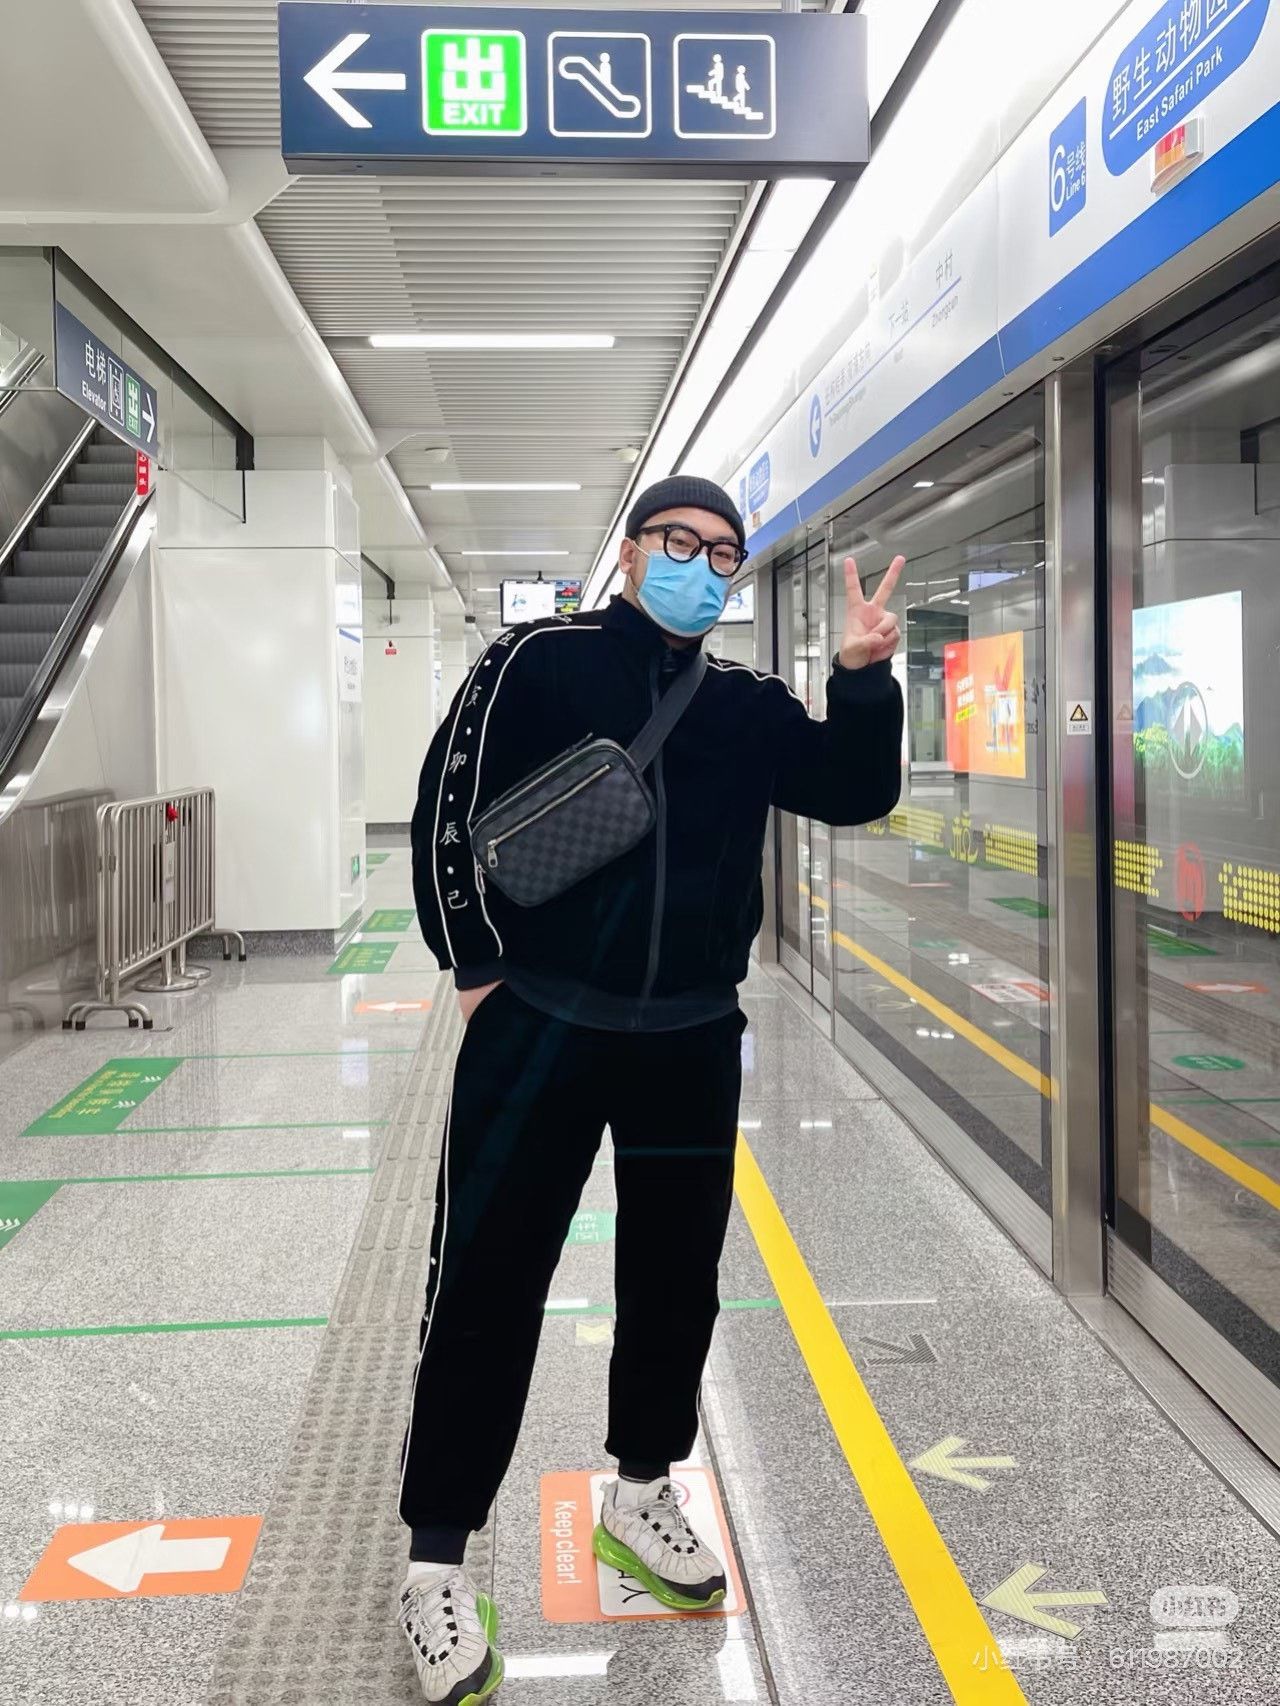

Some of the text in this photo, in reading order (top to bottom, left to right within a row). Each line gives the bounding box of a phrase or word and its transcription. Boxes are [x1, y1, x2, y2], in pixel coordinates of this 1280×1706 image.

[1136, 45, 1223, 141] East Safari Park
[443, 103, 505, 125] EXIT
[1066, 178, 1080, 201] Line
[85, 339, 107, 386] 电梯
[81, 379, 107, 412] Elevator
[128, 417, 139, 434] EXIT
[439, 822, 461, 846] 辰
[549, 1500, 583, 1585] Keep clear!
